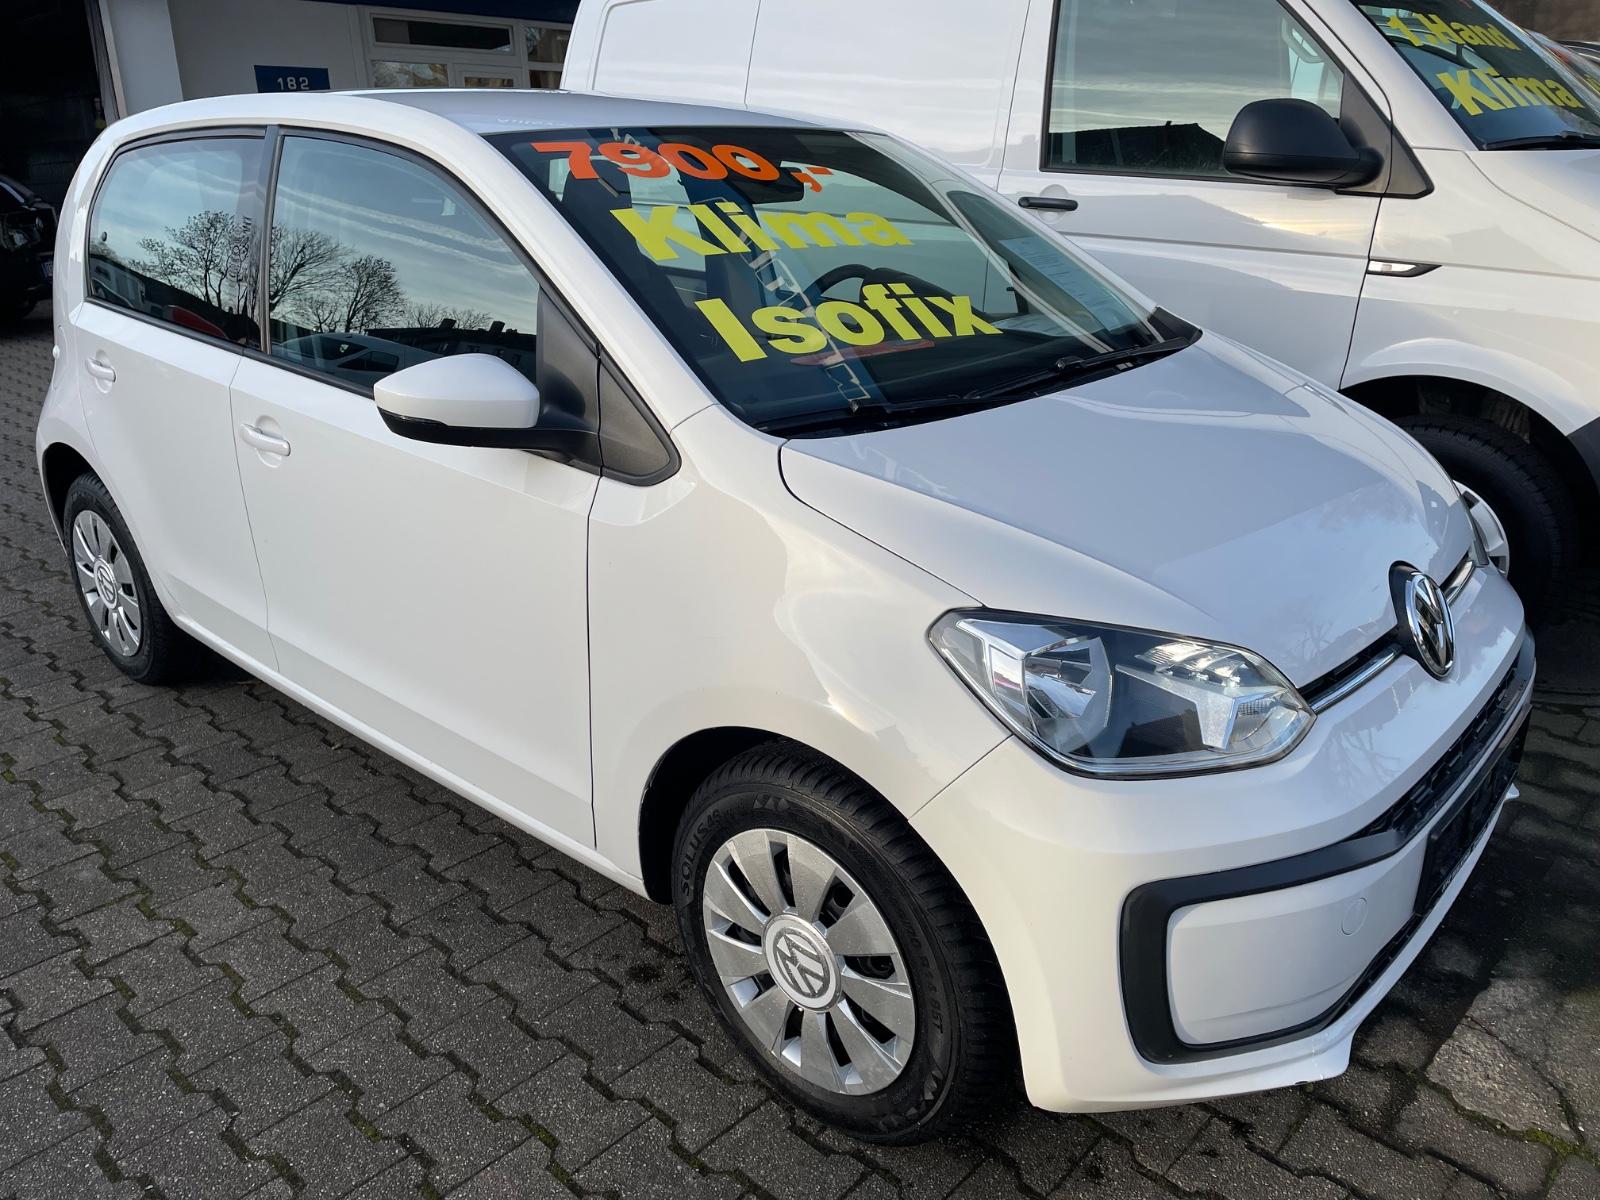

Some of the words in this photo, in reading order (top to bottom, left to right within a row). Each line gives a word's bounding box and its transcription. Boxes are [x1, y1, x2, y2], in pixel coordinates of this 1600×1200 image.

[277, 76, 310, 90] 182
[1436, 67, 1584, 116] Klima
[611, 201, 914, 262] Klima
[695, 283, 1002, 362] Isofix
[680, 820, 709, 897] SOLUS
